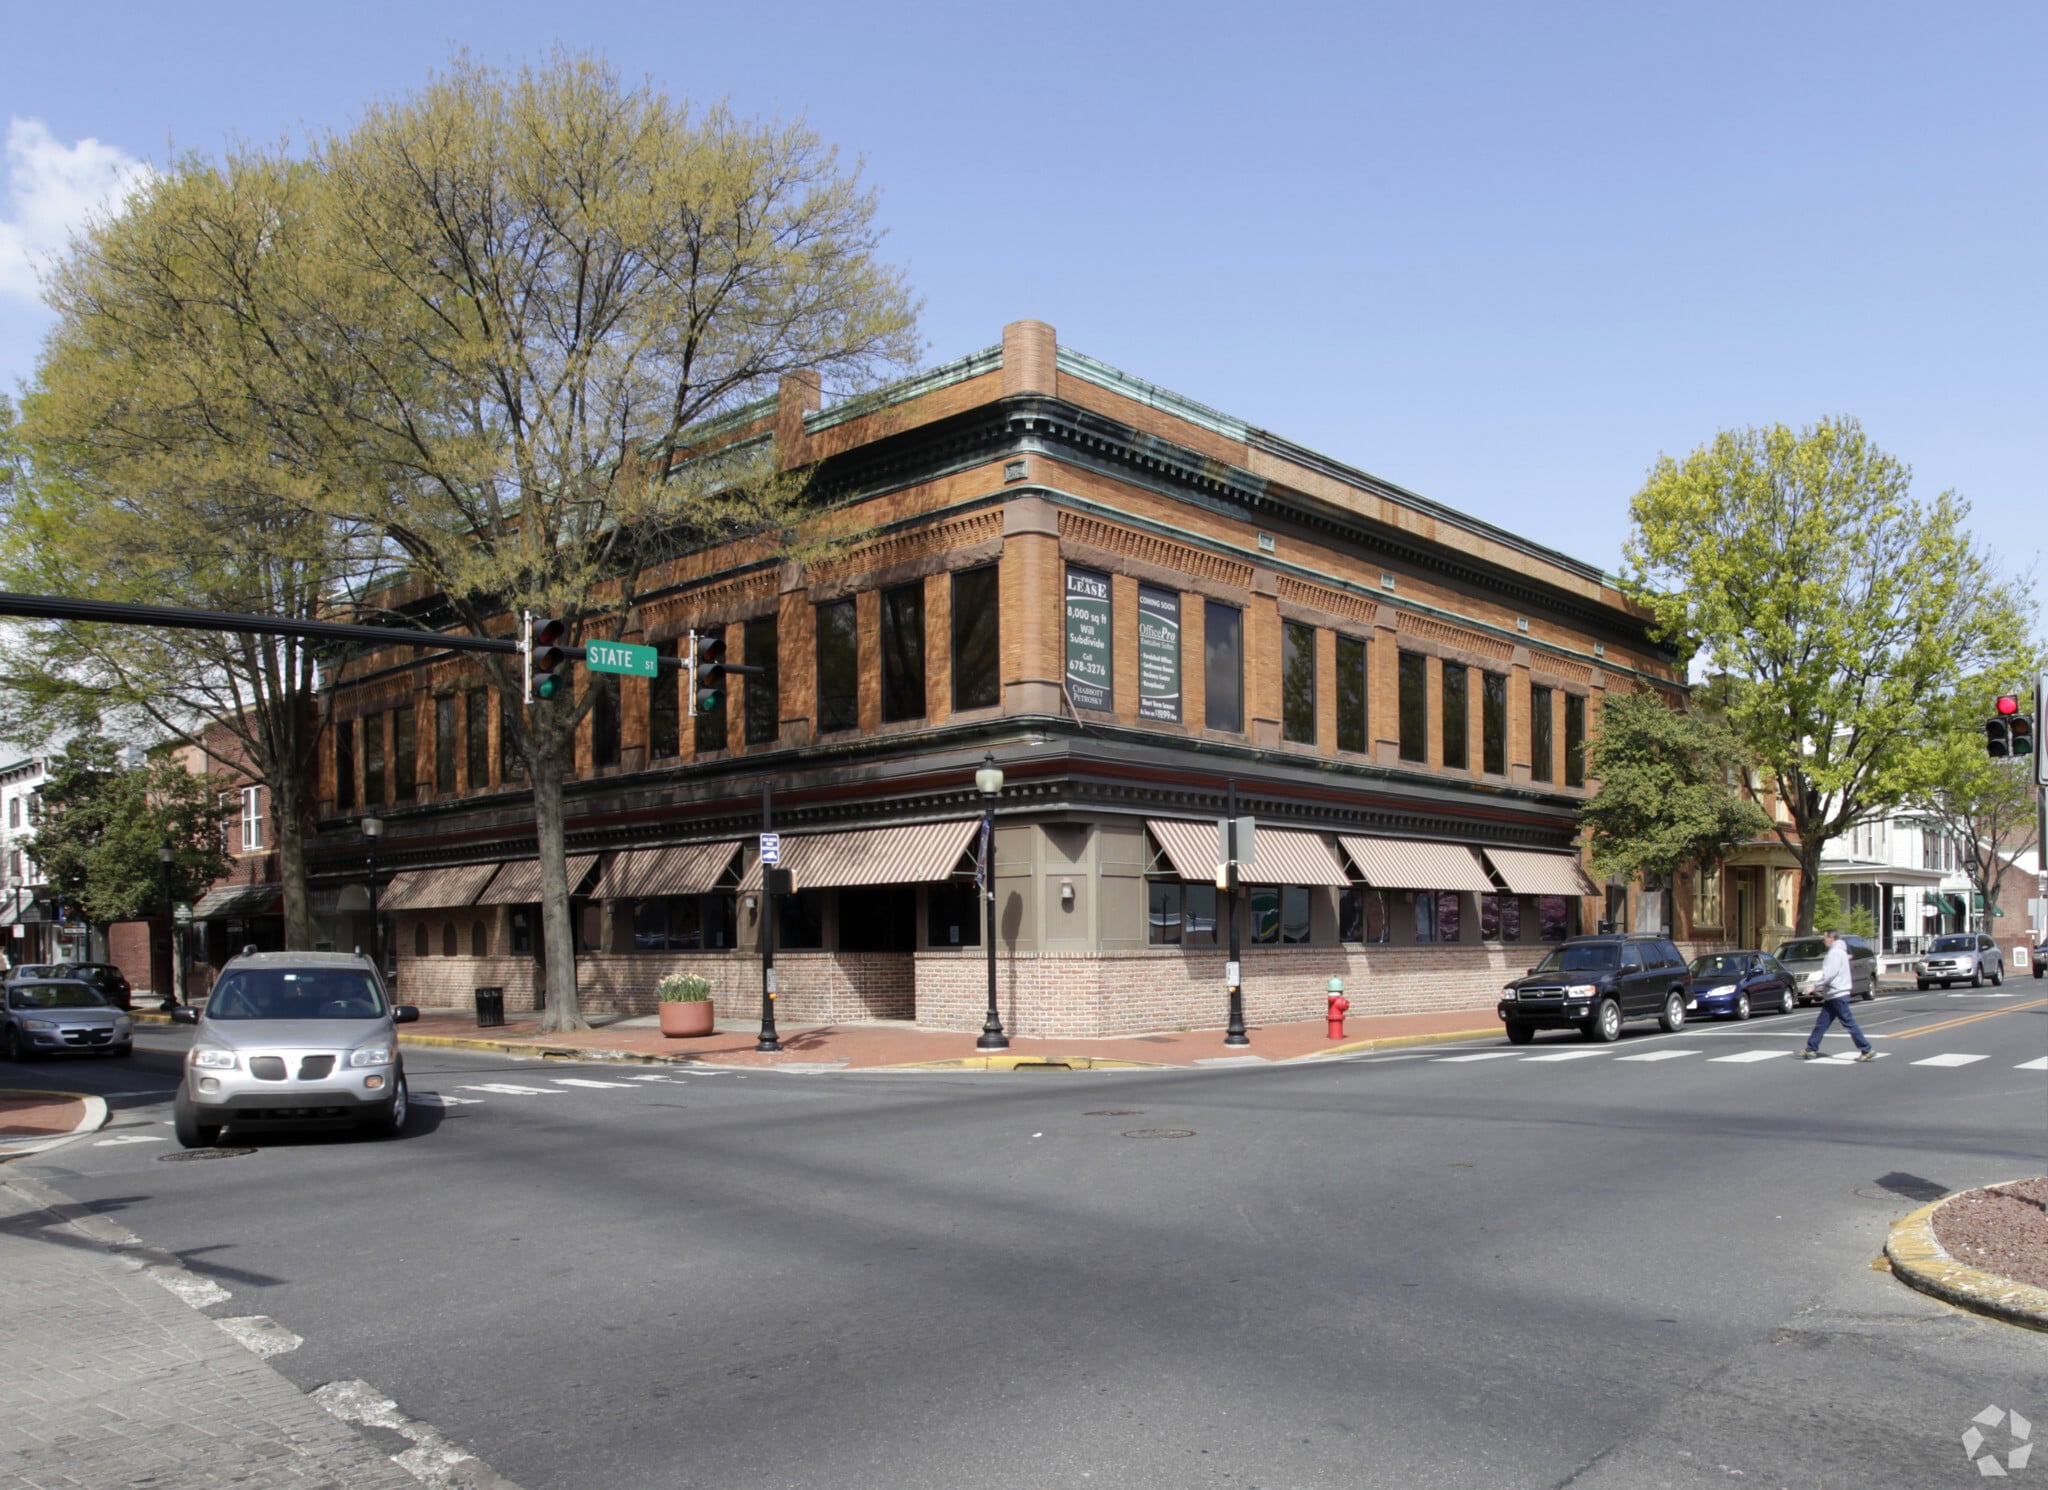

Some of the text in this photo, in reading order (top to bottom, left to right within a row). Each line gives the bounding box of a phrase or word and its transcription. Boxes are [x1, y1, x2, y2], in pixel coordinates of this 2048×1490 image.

[1067, 575, 1107, 598] LEASE
[1139, 596, 1176, 611] COMING SOON
[1067, 606, 1107, 625] 8,000 sq ft
[1080, 624, 1095, 635] Will
[1139, 623, 1176, 641] OfficePro
[1070, 633, 1105, 649] Subdivide
[589, 646, 654, 671] STATE ST
[1082, 652, 1093, 661] Call
[1069, 659, 1106, 676] 678-3276
